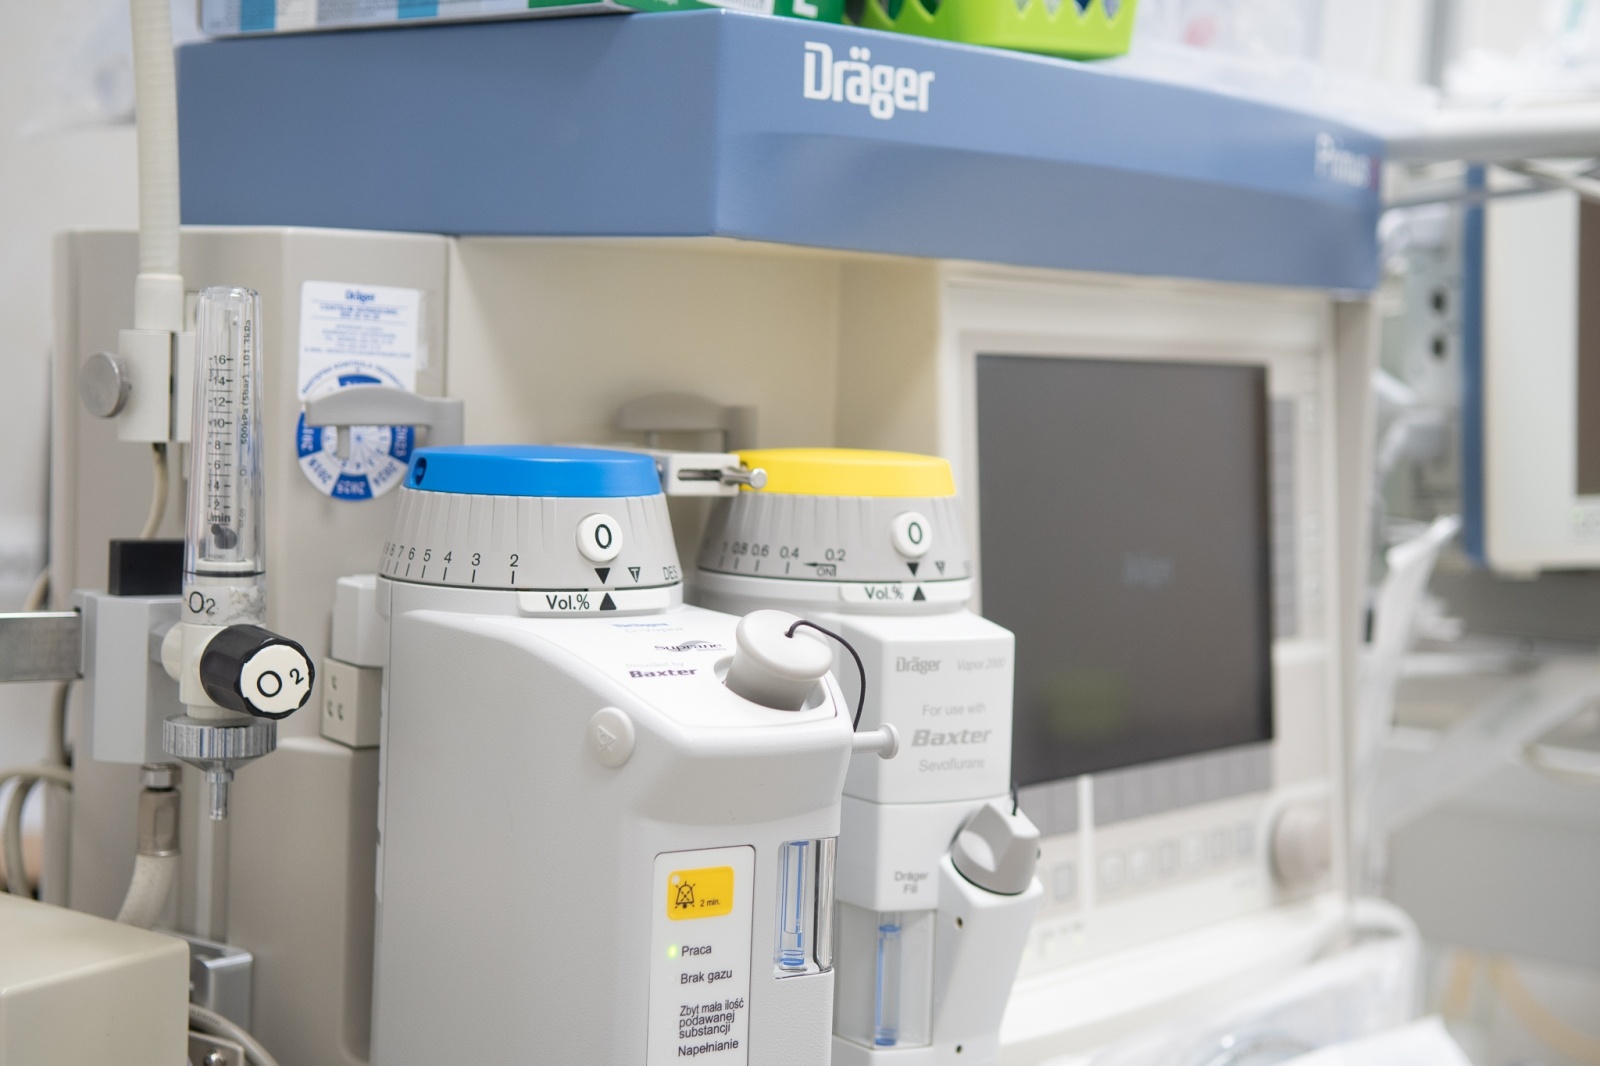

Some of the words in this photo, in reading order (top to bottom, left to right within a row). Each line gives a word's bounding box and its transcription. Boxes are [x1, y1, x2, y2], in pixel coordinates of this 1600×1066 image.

[803, 41, 936, 120] Dräger
[213, 355, 226, 365] 16
[213, 376, 226, 386] 14
[213, 396, 226, 407] 12
[213, 417, 225, 429] 10
[241, 408, 250, 445] 500kPa
[214, 440, 221, 450] 8
[214, 460, 221, 470] 6
[213, 480, 220, 491] 4
[213, 500, 220, 511] 2
[594, 523, 613, 550] 0
[907, 521, 924, 545] 0
[750, 543, 770, 558] 0.6
[779, 545, 800, 559] 0.4
[824, 548, 847, 562] 0.2
[398, 545, 405, 558] 7
[408, 547, 416, 561] 6
[423, 548, 432, 562] 5
[443, 551, 453, 564] 4
[471, 552, 482, 567] 3
[509, 553, 520, 568] 2
[662, 565, 679, 581] DES
[864, 585, 904, 601] Vol.%
[189, 591, 216, 616] O2
[545, 593, 591, 611] Vol.%
[628, 668, 698, 679] Baxter
[895, 656, 941, 676] Dräger
[921, 703, 942, 717] For
[945, 705, 965, 716] use
[967, 702, 987, 715] with
[910, 729, 993, 749] Baxter
[700, 898, 706, 908] 2
[706, 897, 721, 907] min.
[681, 945, 713, 957] Praca
[680, 970, 705, 985] Brak
[707, 969, 733, 984] gazu
[679, 1003, 700, 1018] Zbyt
[701, 1000, 723, 1014] mała
[724, 996, 745, 1012] ilość
[679, 1009, 736, 1031] podawanej
[678, 1020, 732, 1040] substancji
[677, 1038, 740, 1058] Napełnianie
